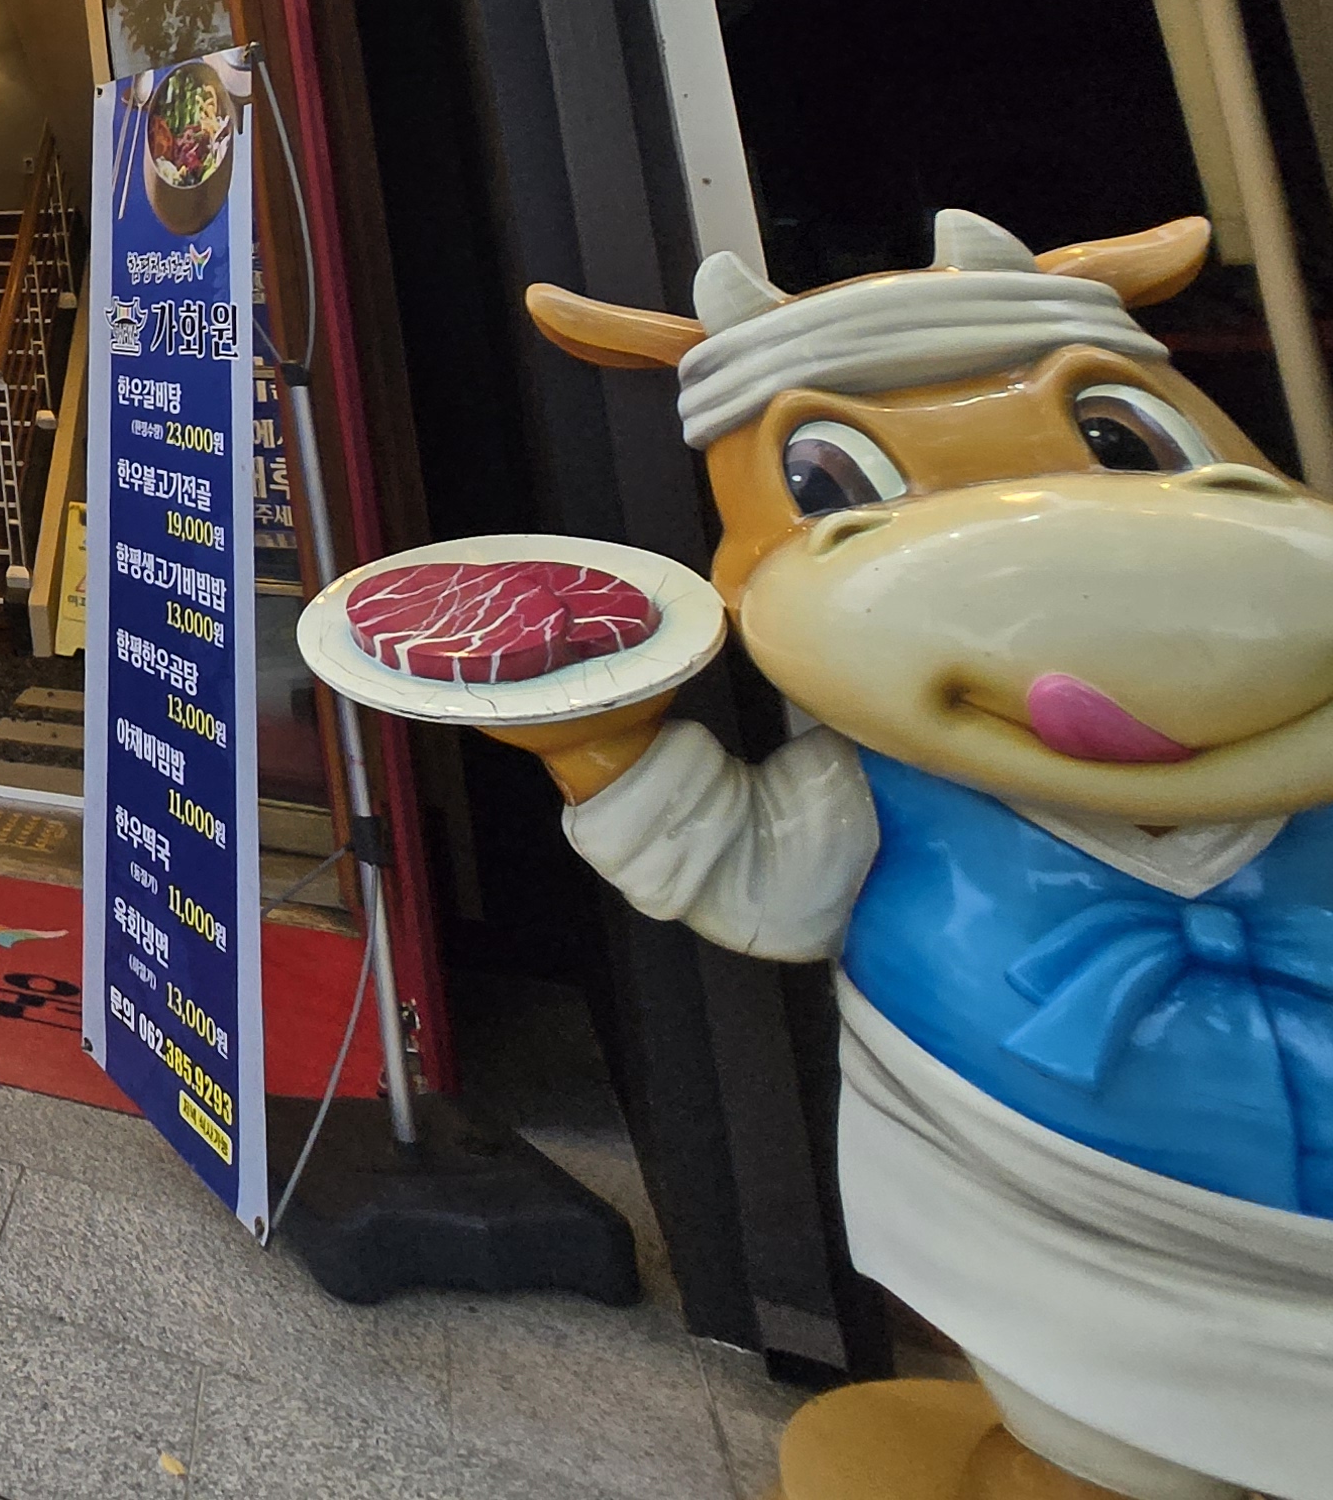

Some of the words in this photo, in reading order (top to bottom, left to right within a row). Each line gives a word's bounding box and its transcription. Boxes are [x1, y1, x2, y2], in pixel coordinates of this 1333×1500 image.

[150, 300, 239, 360] 가화원
[117, 375, 182, 414] 한우갈비탕
[165, 420, 224, 456] 23,000원
[117, 458, 212, 512] 한우불고기전골
[166, 510, 225, 551] 19,000원
[116, 542, 227, 613] 함평생고기비빔밥
[166, 600, 225, 649] 13,000원
[116, 628, 199, 696] 함평한우곰탕
[117, 717, 186, 785] 야채비빔밥
[167, 694, 227, 749] 13,000원
[115, 804, 171, 872] 한우떡국
[168, 789, 226, 850] 11,000원
[113, 896, 169, 969] 육회냉면
[130, 860, 159, 895] (동절기)
[168, 885, 227, 953] 11,000원
[166, 981, 229, 1060] 13,000원
[110, 985, 136, 1033] 문의
[138, 1012, 233, 1126] 062.385.9293
